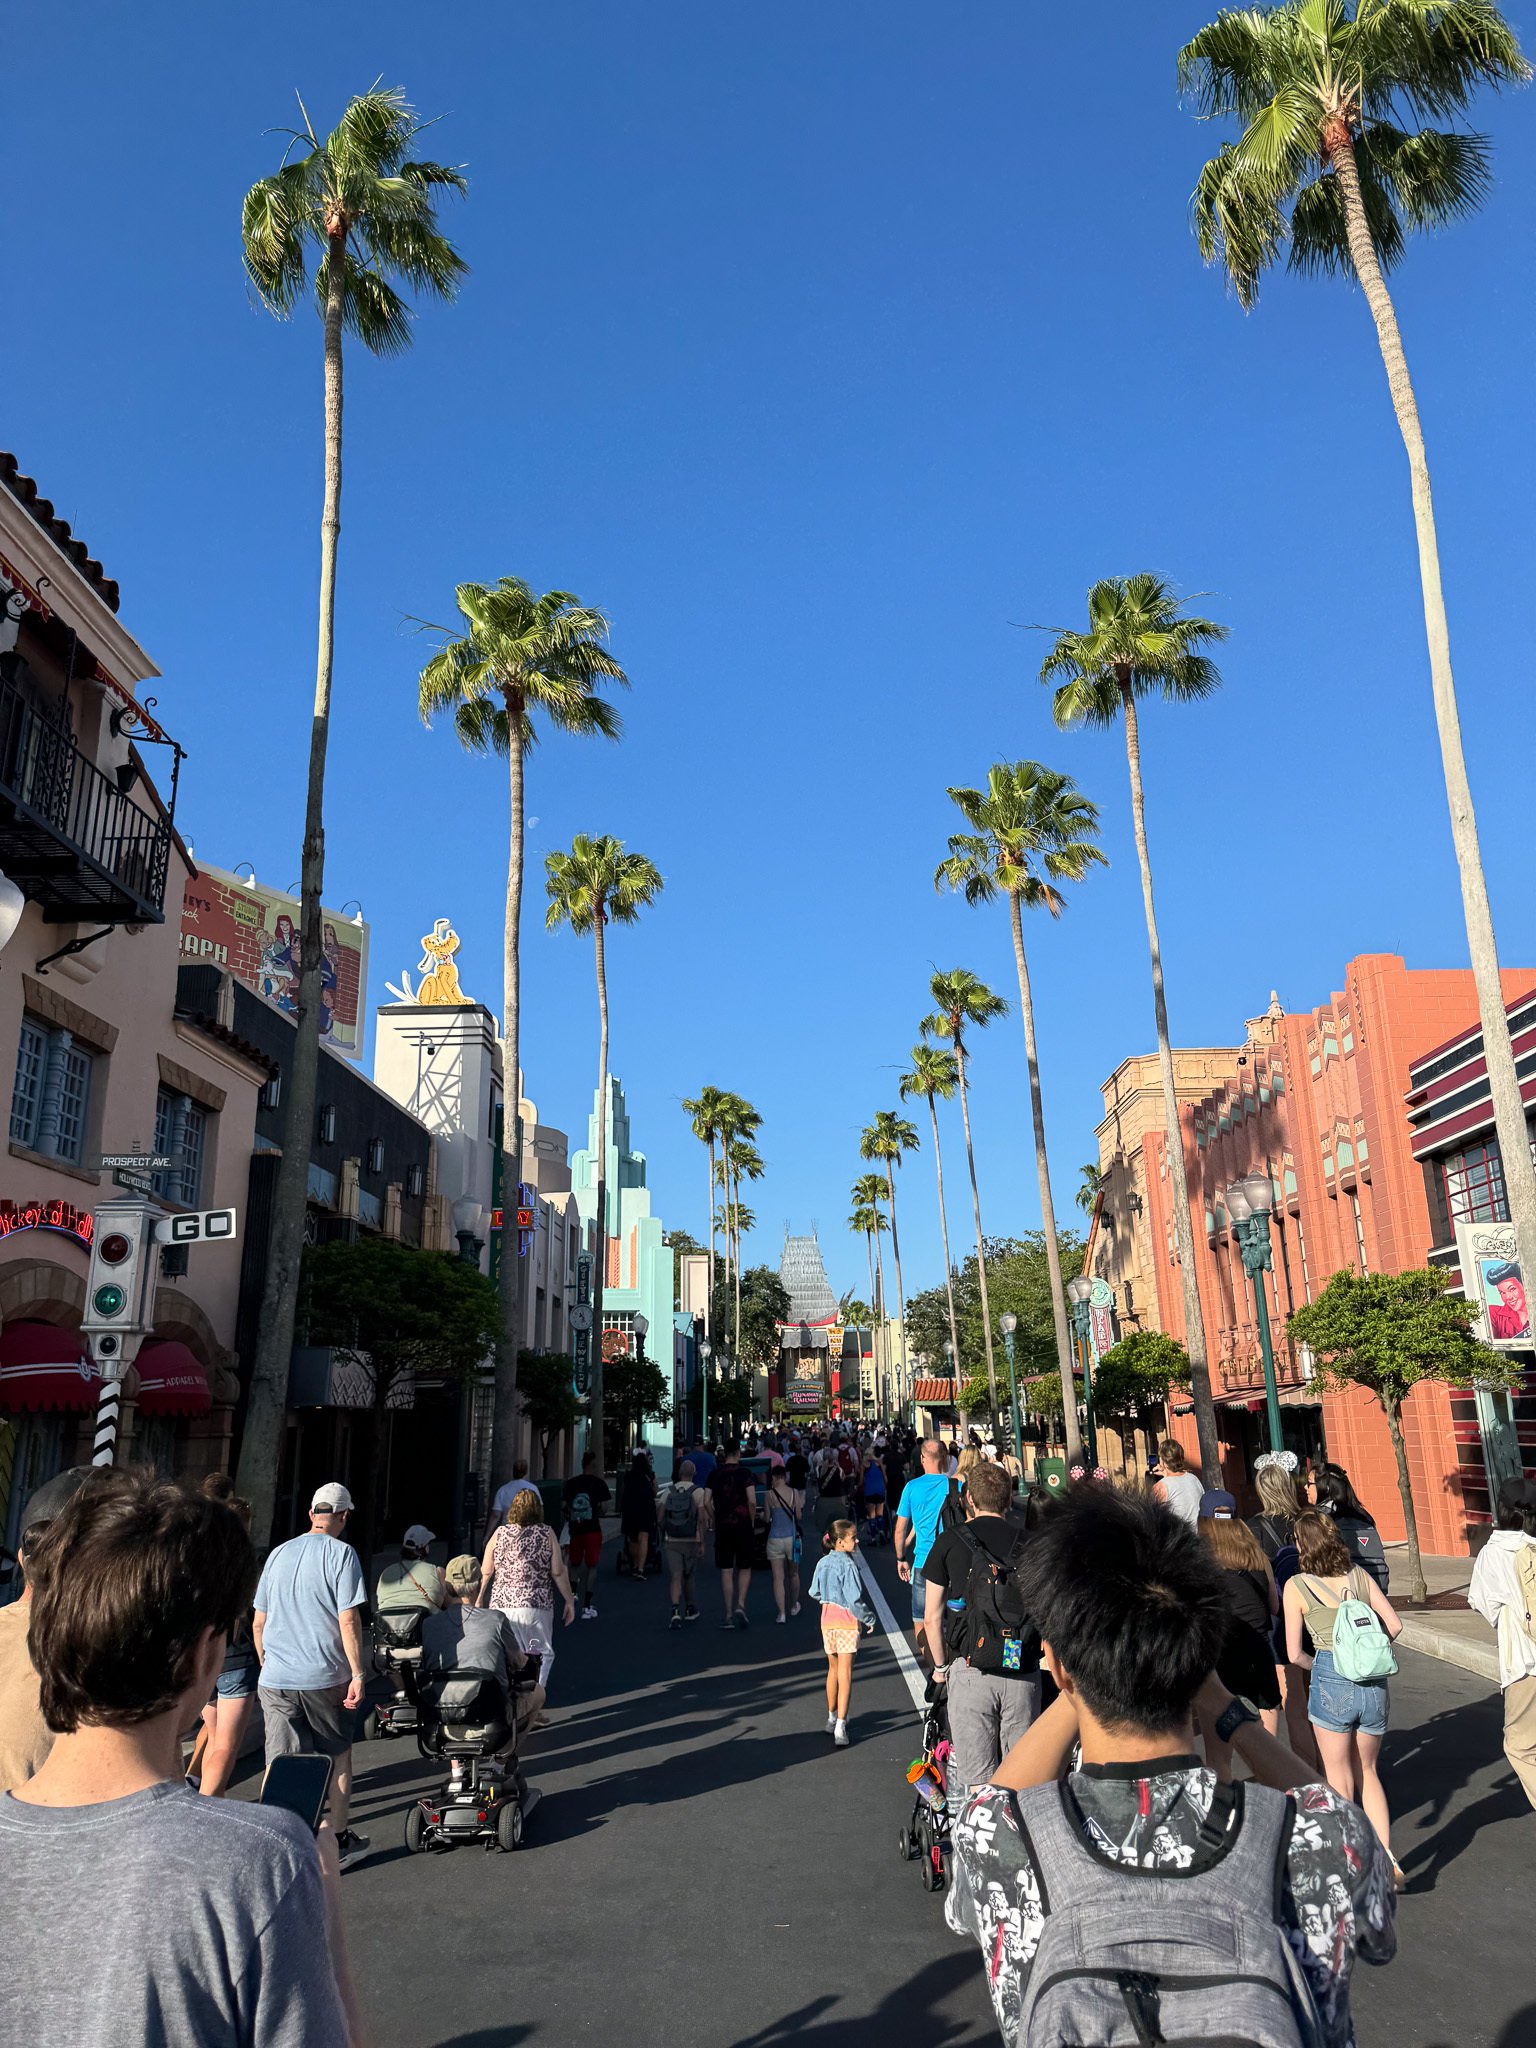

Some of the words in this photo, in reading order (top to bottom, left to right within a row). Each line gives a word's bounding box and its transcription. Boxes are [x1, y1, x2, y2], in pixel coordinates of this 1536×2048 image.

[182, 908, 199, 924] uck
[102, 1157, 151, 1166] PROSPECT
[152, 1157, 172, 1167] AVE.
[119, 1172, 142, 1188] HOLLYWOOD
[50, 1201, 64, 1226] of
[172, 1211, 232, 1241] GO
